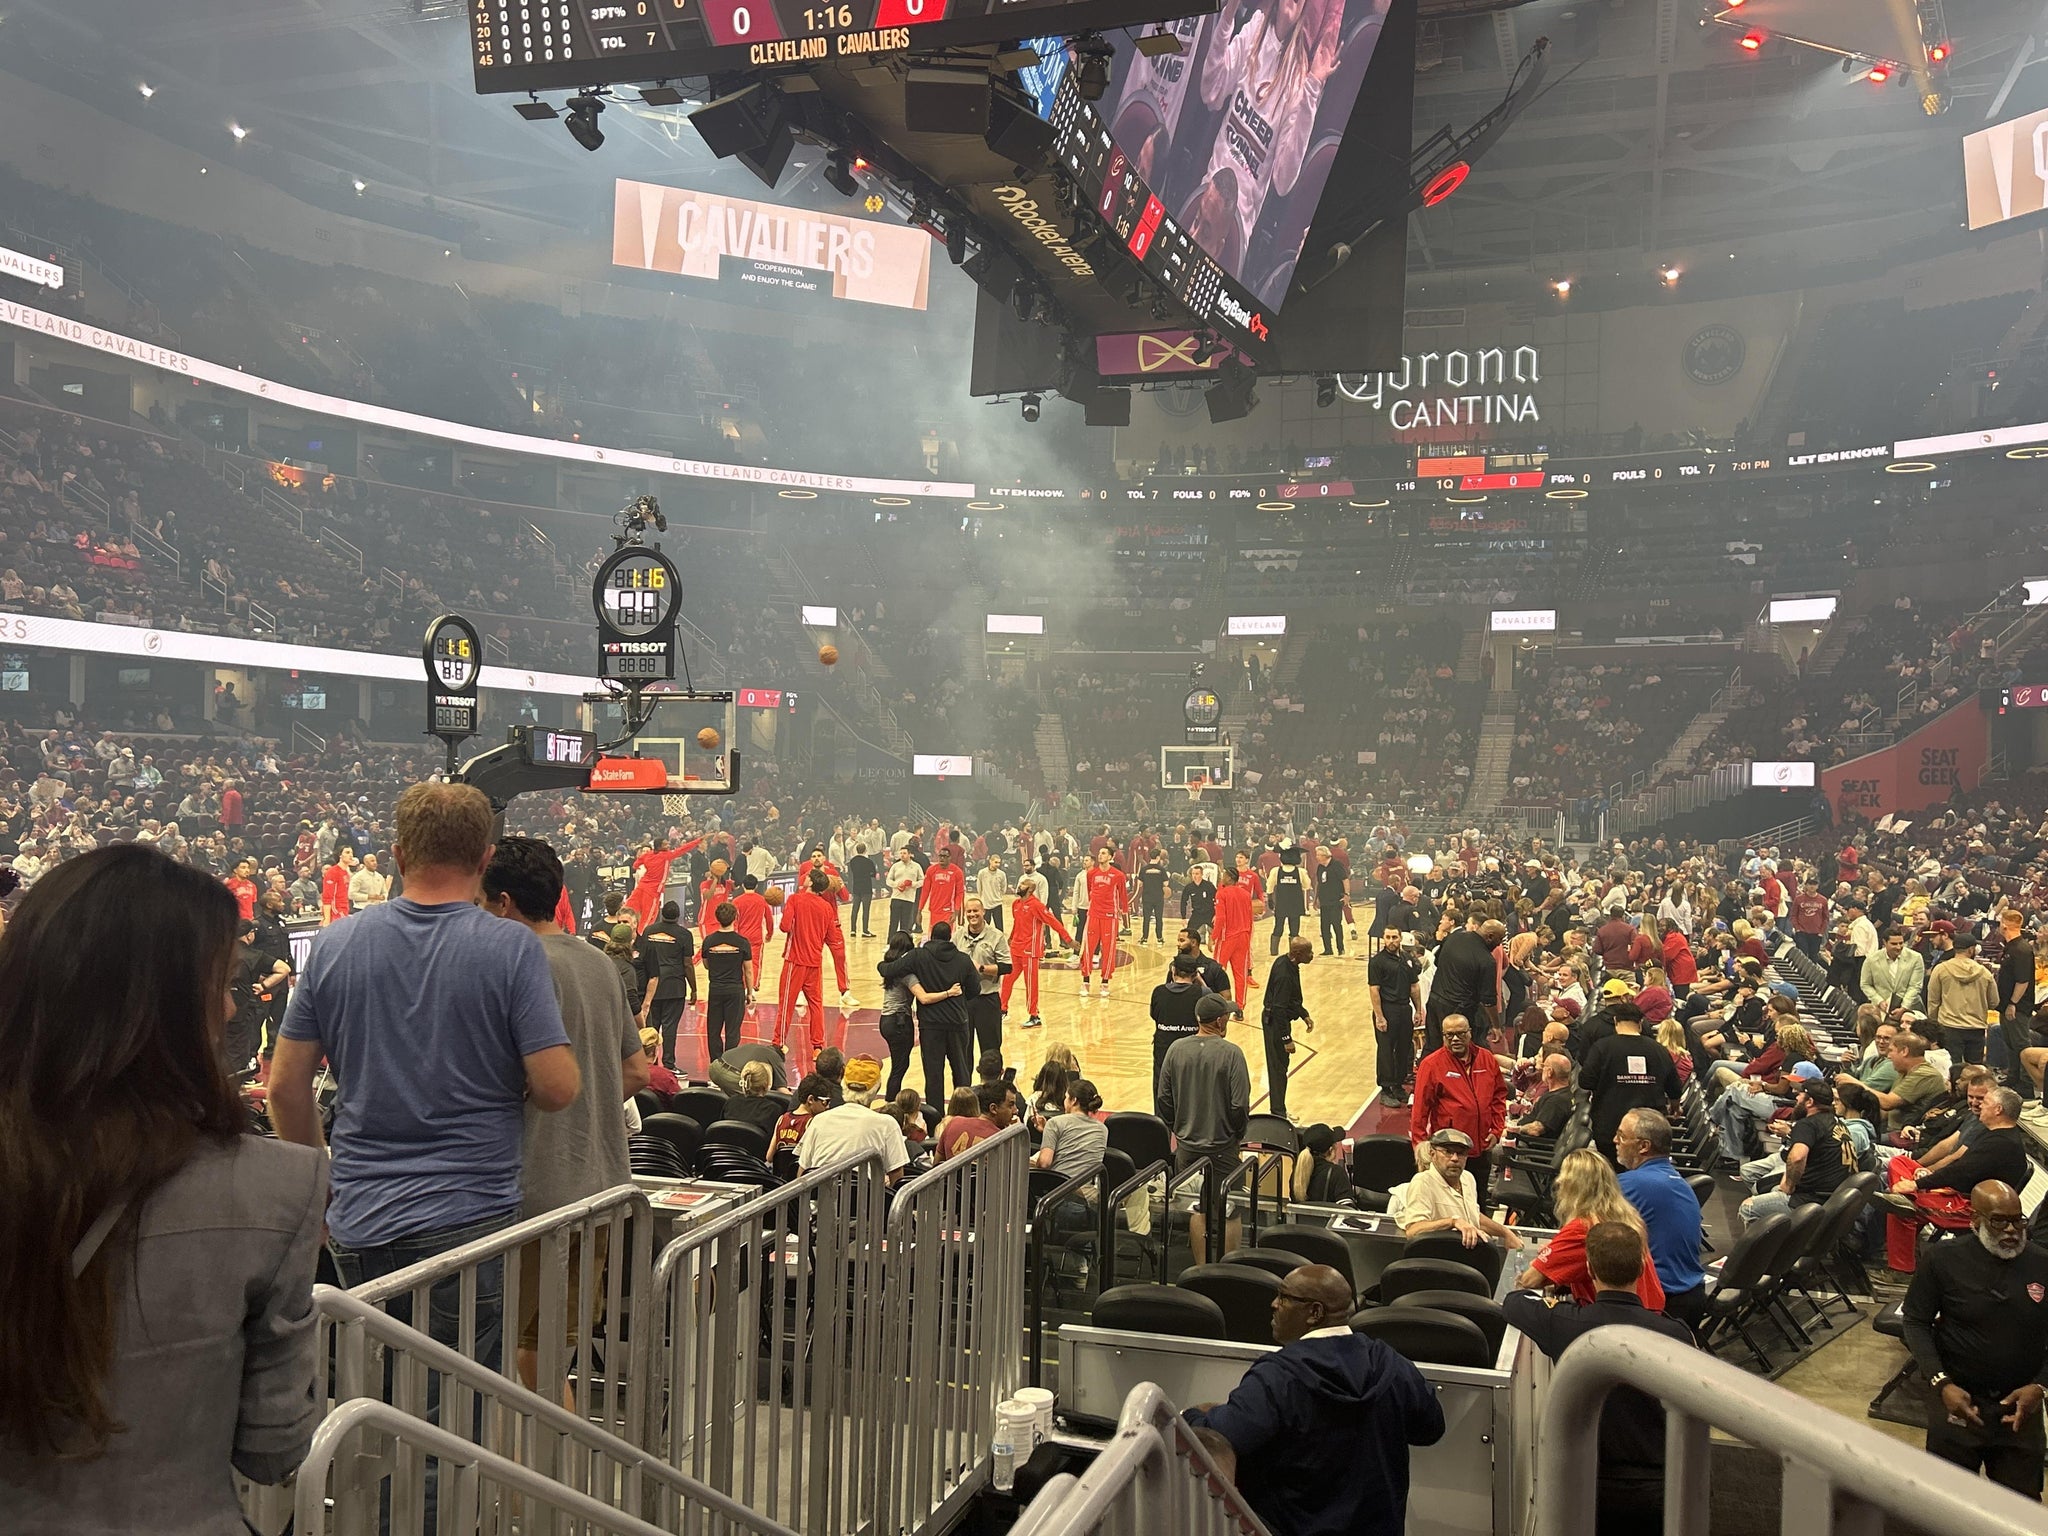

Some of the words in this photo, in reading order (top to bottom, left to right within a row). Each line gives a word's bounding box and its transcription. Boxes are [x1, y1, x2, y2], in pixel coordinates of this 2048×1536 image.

[475, 13, 490, 24] 12
[500, 10, 508, 22] 0
[521, 9, 530, 20] 0
[542, 6, 550, 18] 0
[561, 5, 569, 17] 0
[591, 6, 627, 20] 3PT%
[637, 1, 647, 16] 0
[803, 5, 853, 31] 1:16
[476, 26, 491, 38] 20
[501, 25, 510, 36] 0
[522, 23, 531, 34] 0
[543, 20, 551, 32] 0
[562, 18, 570, 31] 0
[733, 7, 751, 36] 0
[478, 41, 492, 53] 31
[502, 38, 511, 50] 0
[523, 37, 532, 48] 0
[544, 34, 552, 46] 0
[563, 33, 571, 45] 0
[600, 36, 627, 49] TOL
[646, 32, 656, 46] 7
[750, 39, 828, 66] CLEVELAND
[837, 27, 910, 56] CAVALIERS
[479, 54, 494, 66] 45
[503, 53, 512, 64] 0
[524, 51, 533, 62] 0
[545, 49, 554, 60] 0
[564, 47, 573, 59] 0
[1234, 89, 1274, 150] CHEER
[1103, 189, 1112, 211] 0
[1115, 214, 1131, 239] 1:16
[677, 200, 876, 280] CAVALIERS
[1003, 199, 1069, 245] Rocket
[1047, 245, 1095, 276] Arena
[1136, 232, 1146, 252] 0
[0, 254, 60, 283] VALIERS
[754, 262, 805, 277] COOPERATION,
[741, 273, 757, 282] AND
[757, 275, 780, 286] ENJOY
[781, 278, 795, 288] THE
[795, 281, 817, 291] GAME!
[1216, 287, 1252, 329] KeyBank
[92, 330, 190, 372] CAVALIERS
[1390, 393, 1540, 431] CANTINA
[1788, 452, 1817, 466] LET
[1817, 452, 1841, 463] EM
[1840, 445, 1889, 461] KNOW.
[672, 461, 763, 480] CLEVELAND
[770, 471, 854, 489] CAVALIERS
[1395, 481, 1416, 491] 1:16
[1436, 479, 1454, 490] 1Q
[1509, 475, 1518, 486] 0
[1551, 473, 1575, 484] FG%
[1582, 473, 1591, 484] 0
[1612, 469, 1646, 481] FOULS
[1654, 468, 1662, 479] 0
[1679, 465, 1700, 476] TOL
[1708, 464, 1716, 474] 7
[1731, 461, 1752, 471] 7:01
[1754, 459, 1770, 470] PM
[989, 487, 1011, 498] LET
[1011, 488, 1028, 498] EM
[1028, 488, 1065, 499] KNOW.
[1100, 489, 1107, 500] 0
[1127, 490, 1146, 499] TOL
[1151, 490, 1159, 500] 7
[1173, 490, 1203, 499] FOULS
[1209, 490, 1217, 500] 0
[1229, 489, 1251, 499] FG%
[1259, 488, 1266, 498] 0
[1320, 484, 1328, 495] 0
[632, 567, 665, 589] 1:16
[1493, 616, 1553, 625] CAVALIERS
[620, 642, 667, 653] TISSOT
[447, 697, 476, 707] TISSOT
[747, 692, 755, 704] 0
[789, 698, 795, 707] 0
[2002, 696, 2009, 706] 0
[556, 739, 582, 763] TIP-OFF
[1921, 748, 1960, 766] SEAT
[858, 768, 907, 778] LECOM
[1918, 767, 1961, 786] GEEK
[1841, 779, 1880, 793] SEAT
